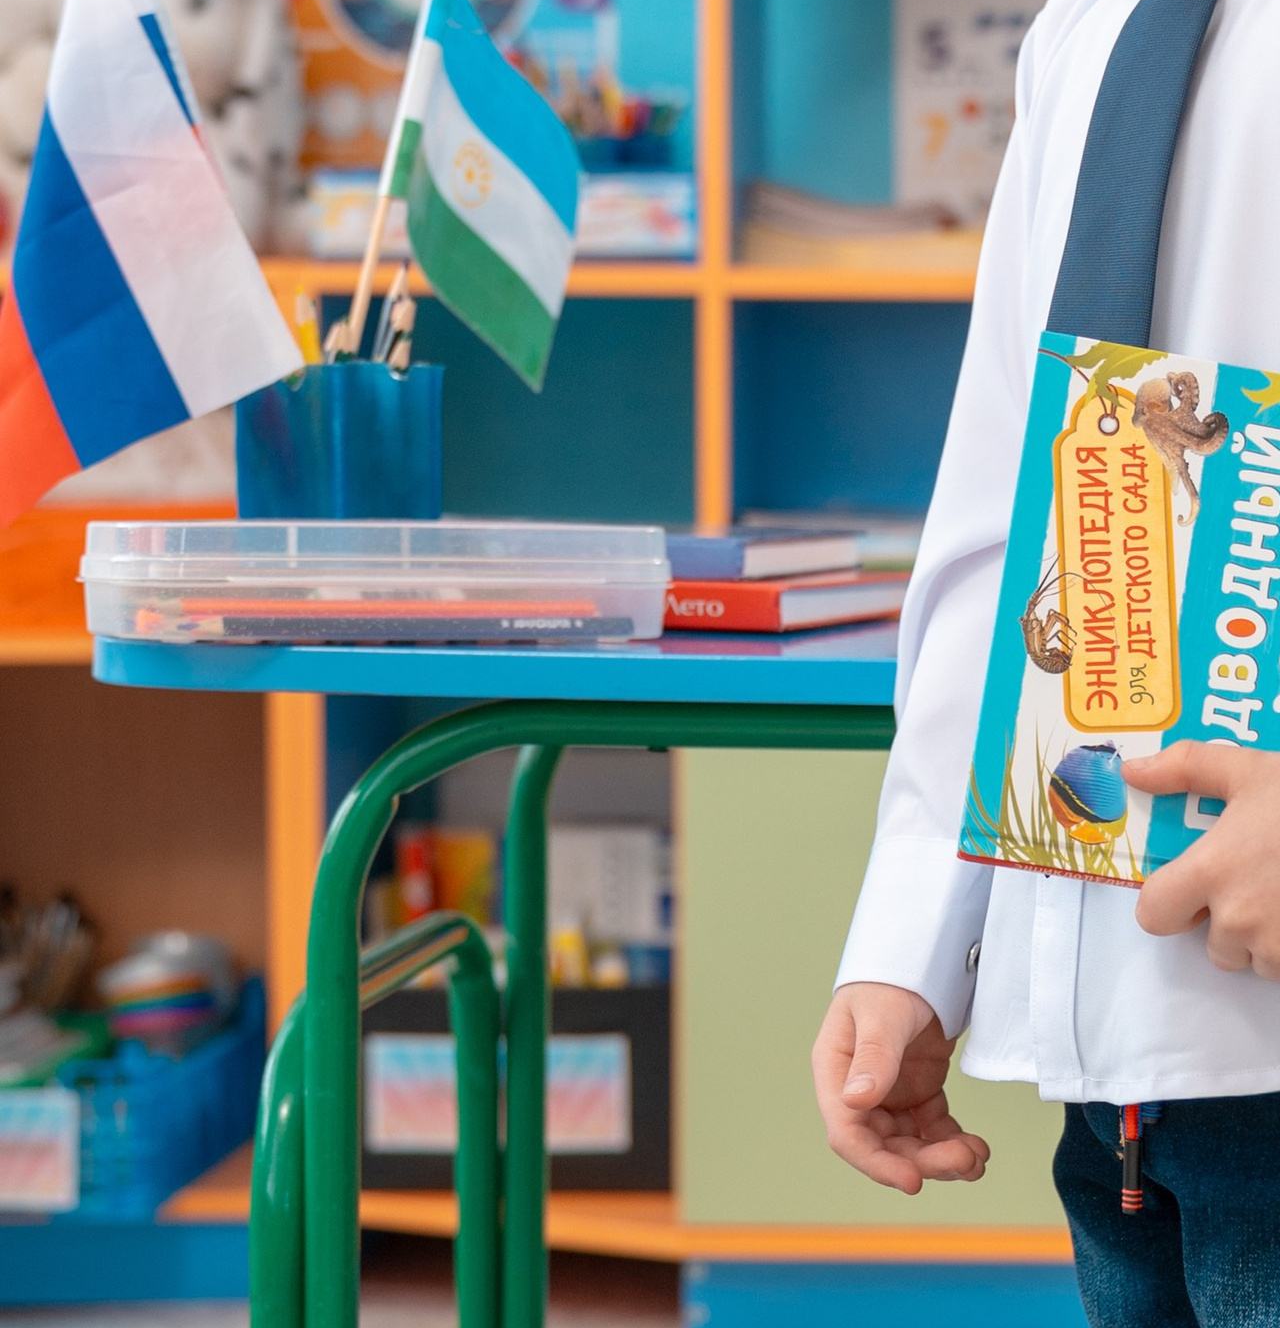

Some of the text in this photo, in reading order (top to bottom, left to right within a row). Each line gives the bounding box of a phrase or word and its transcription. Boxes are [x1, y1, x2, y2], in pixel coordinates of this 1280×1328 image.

[1076, 446, 1119, 711] ЭНЦИКЛОПЕДИЯ
[1121, 443, 1158, 705] для ДЕТСКОГО САДА
